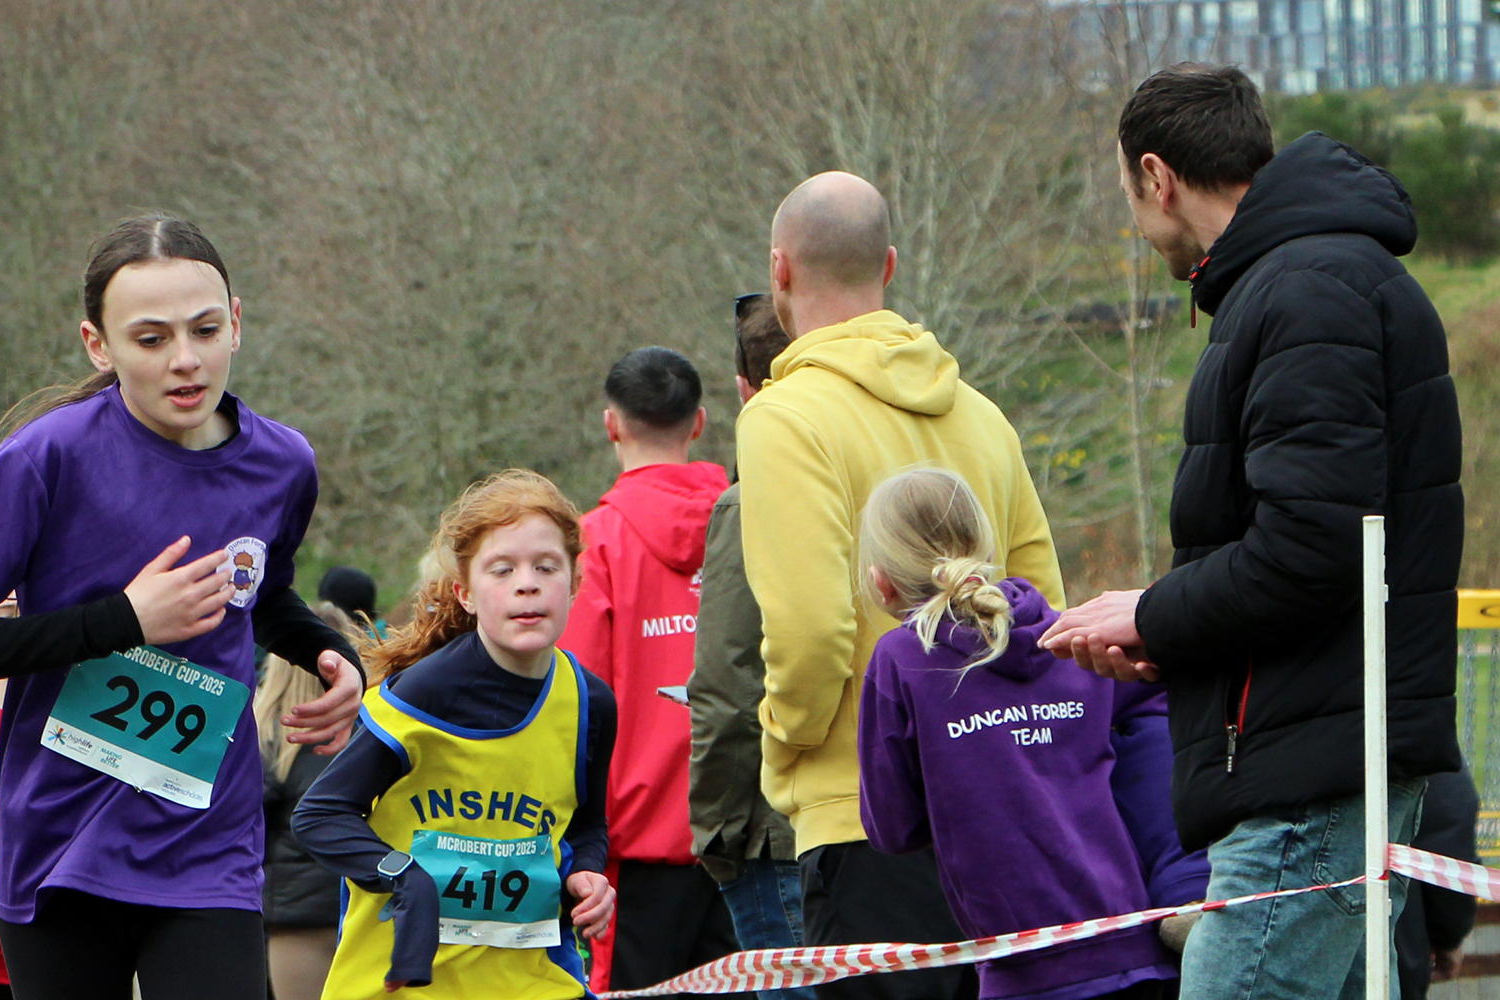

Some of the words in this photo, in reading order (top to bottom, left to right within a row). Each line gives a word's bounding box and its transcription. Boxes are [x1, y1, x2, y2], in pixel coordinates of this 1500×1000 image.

[228, 538, 250, 552] Duncan
[642, 614, 699, 638] MILTO
[113, 646, 178, 677] CROBERT
[176, 664, 200, 686] CUP
[199, 674, 226, 697] 2025
[90, 675, 207, 755] 299
[947, 705, 1028, 739] DUNCAN
[1031, 701, 1085, 721] FORBES
[67, 733, 94, 750] highlife
[1010, 727, 1053, 746] TEAM
[409, 788, 557, 836] INSHES
[436, 835, 494, 857] MCROBERT
[493, 843, 515, 858] CUP
[515, 840, 537, 857] 2025
[441, 866, 530, 912] 419
